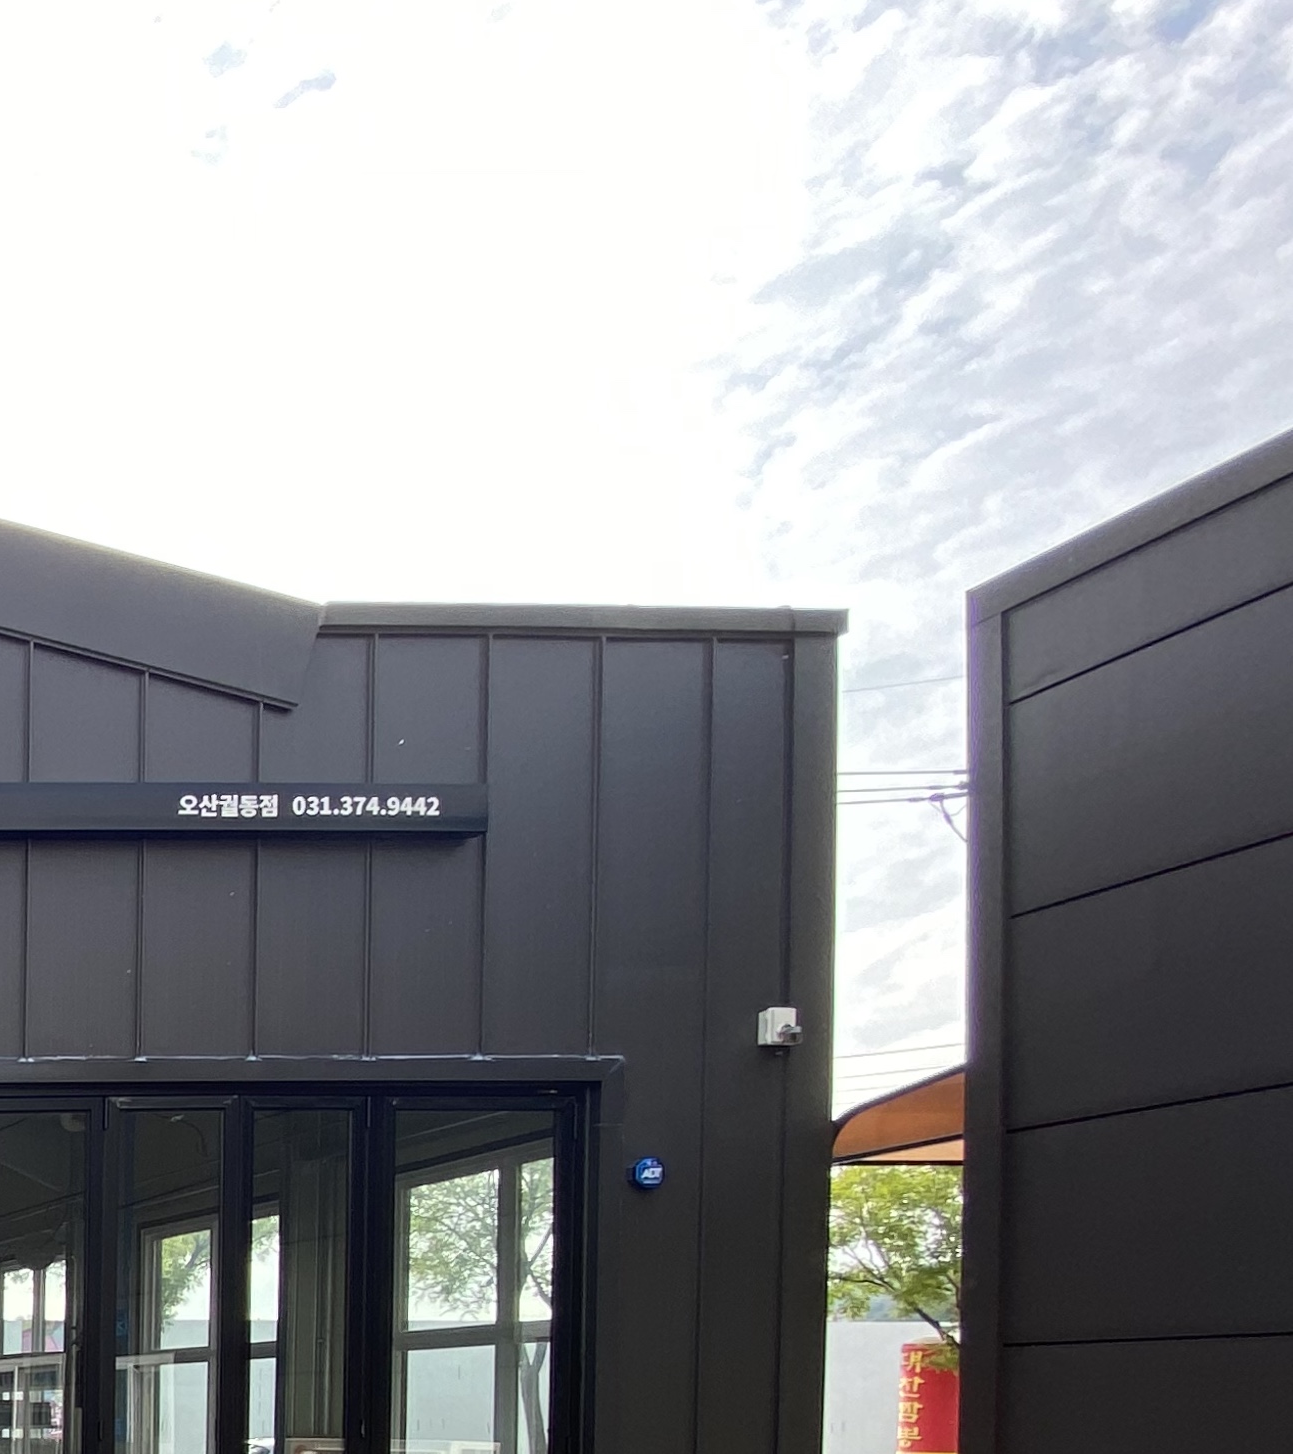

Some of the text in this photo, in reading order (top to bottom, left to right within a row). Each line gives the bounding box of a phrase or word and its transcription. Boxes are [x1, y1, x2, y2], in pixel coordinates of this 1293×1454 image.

[177, 794, 440, 818] 오산궐동점 031.374.9442
[641, 1167, 663, 1179] ADT
